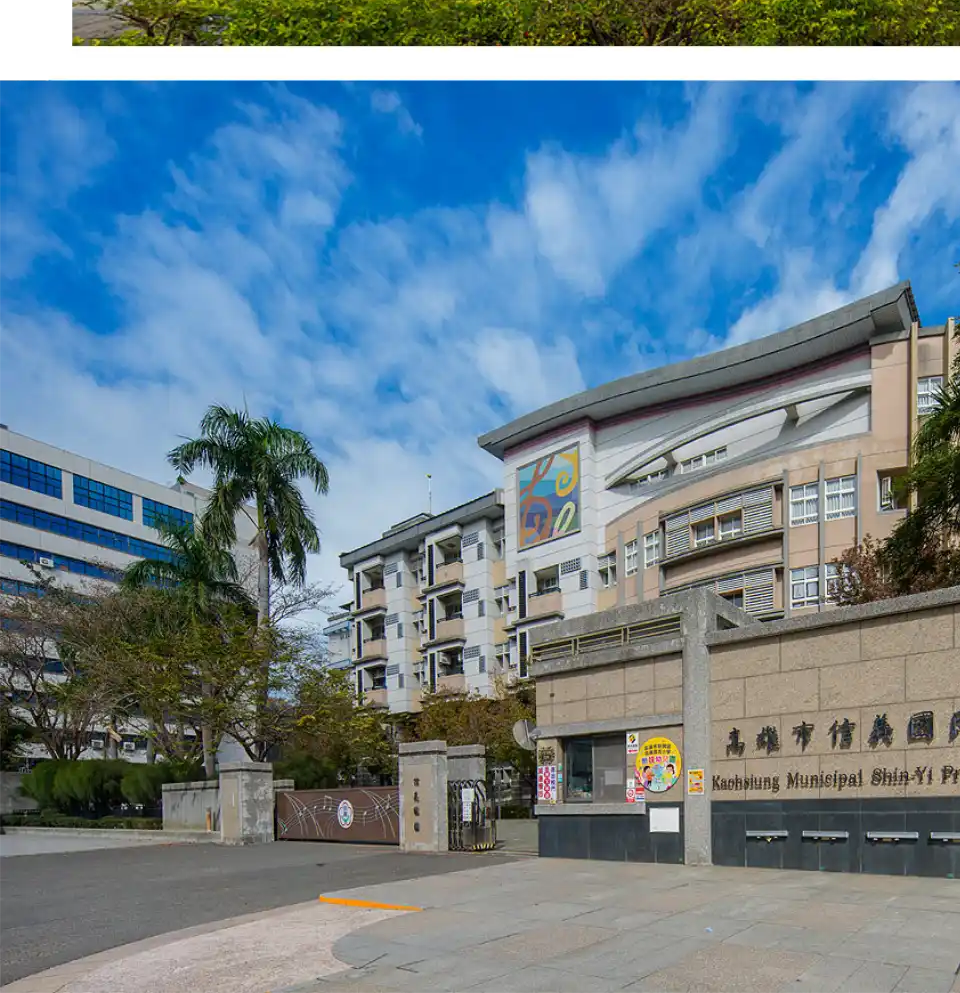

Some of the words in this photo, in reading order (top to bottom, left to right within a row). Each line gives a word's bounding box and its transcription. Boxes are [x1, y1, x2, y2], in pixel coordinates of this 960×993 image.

[712, 773, 780, 793] Kaohsiung
[786, 768, 863, 791] Municipal
[871, 765, 933, 787] Shin-Yi
